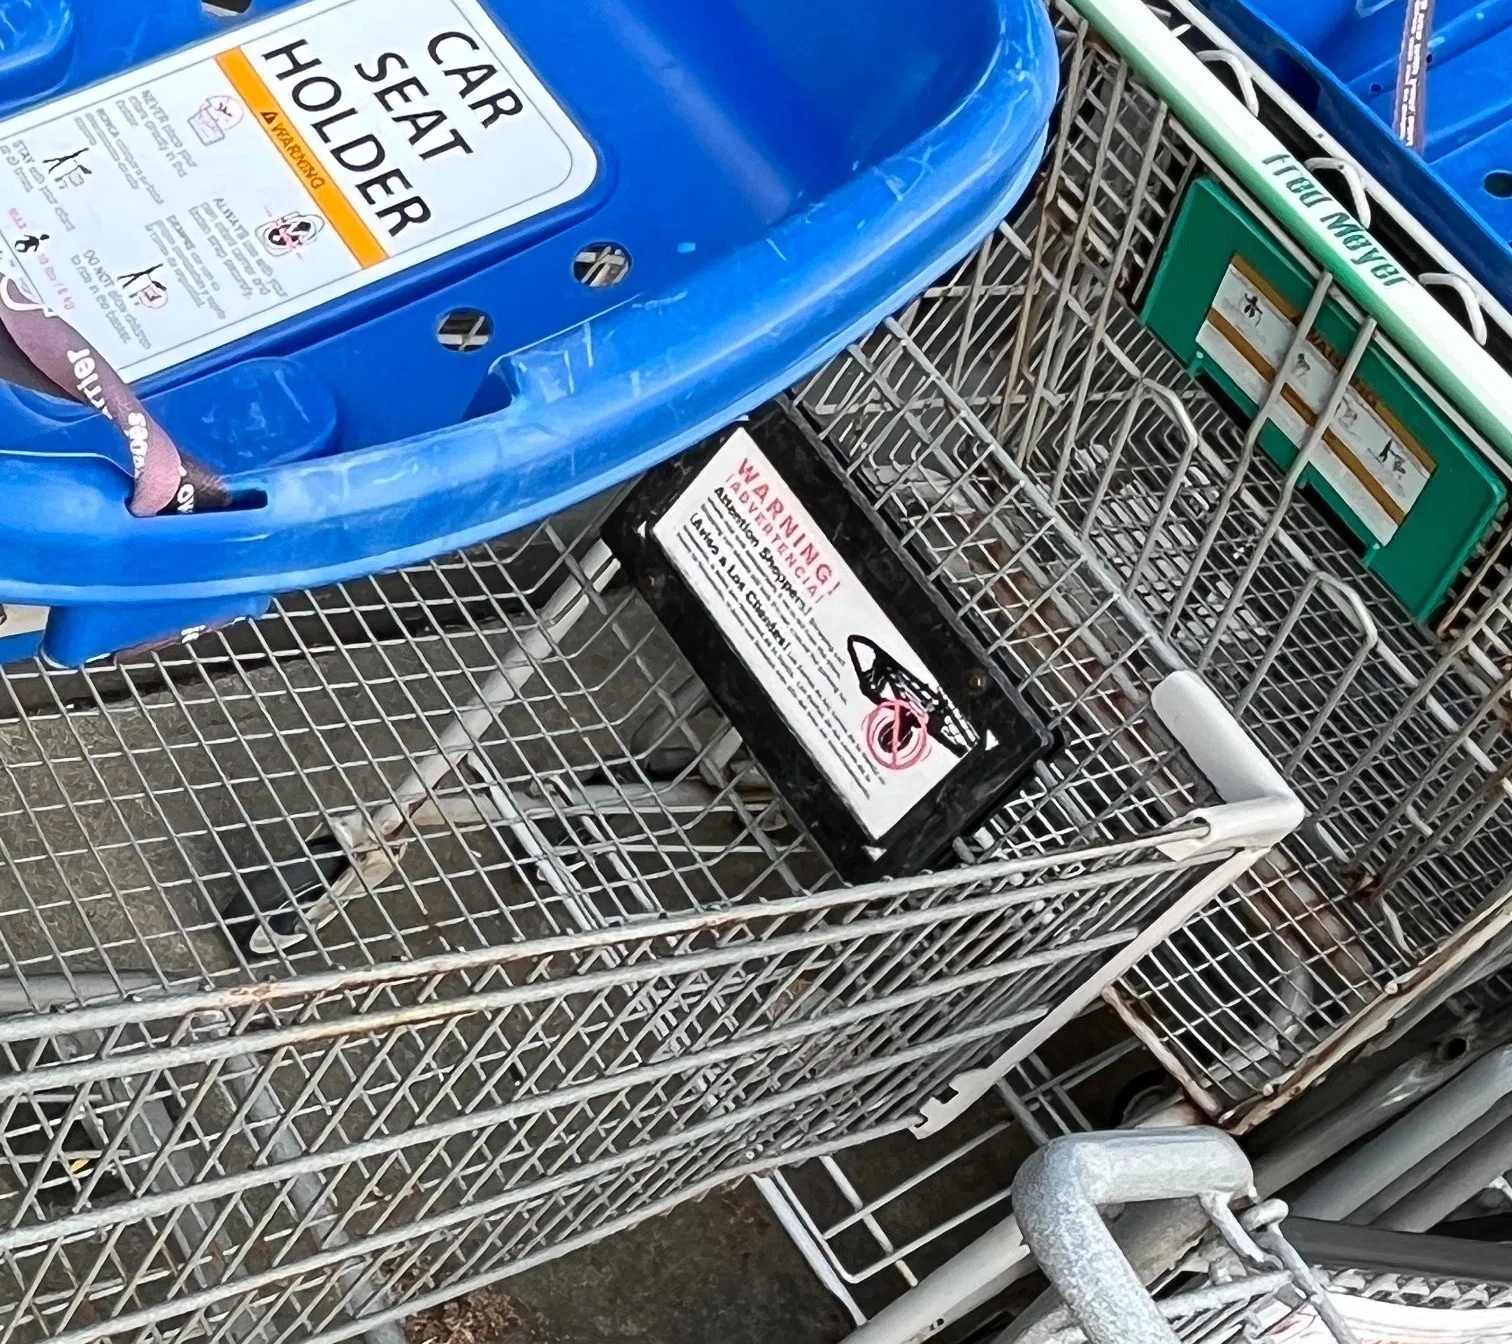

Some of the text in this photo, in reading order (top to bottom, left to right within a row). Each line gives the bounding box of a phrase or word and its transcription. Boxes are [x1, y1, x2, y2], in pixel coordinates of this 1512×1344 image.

[263, 38, 431, 238] HOLDER
[355, 52, 473, 162] SEAT
[427, 31, 523, 130] CAR
[271, 120, 326, 192] WARNING
[712, 483, 813, 619] Attention Shoppers!
[734, 456, 843, 597] WARNING!
